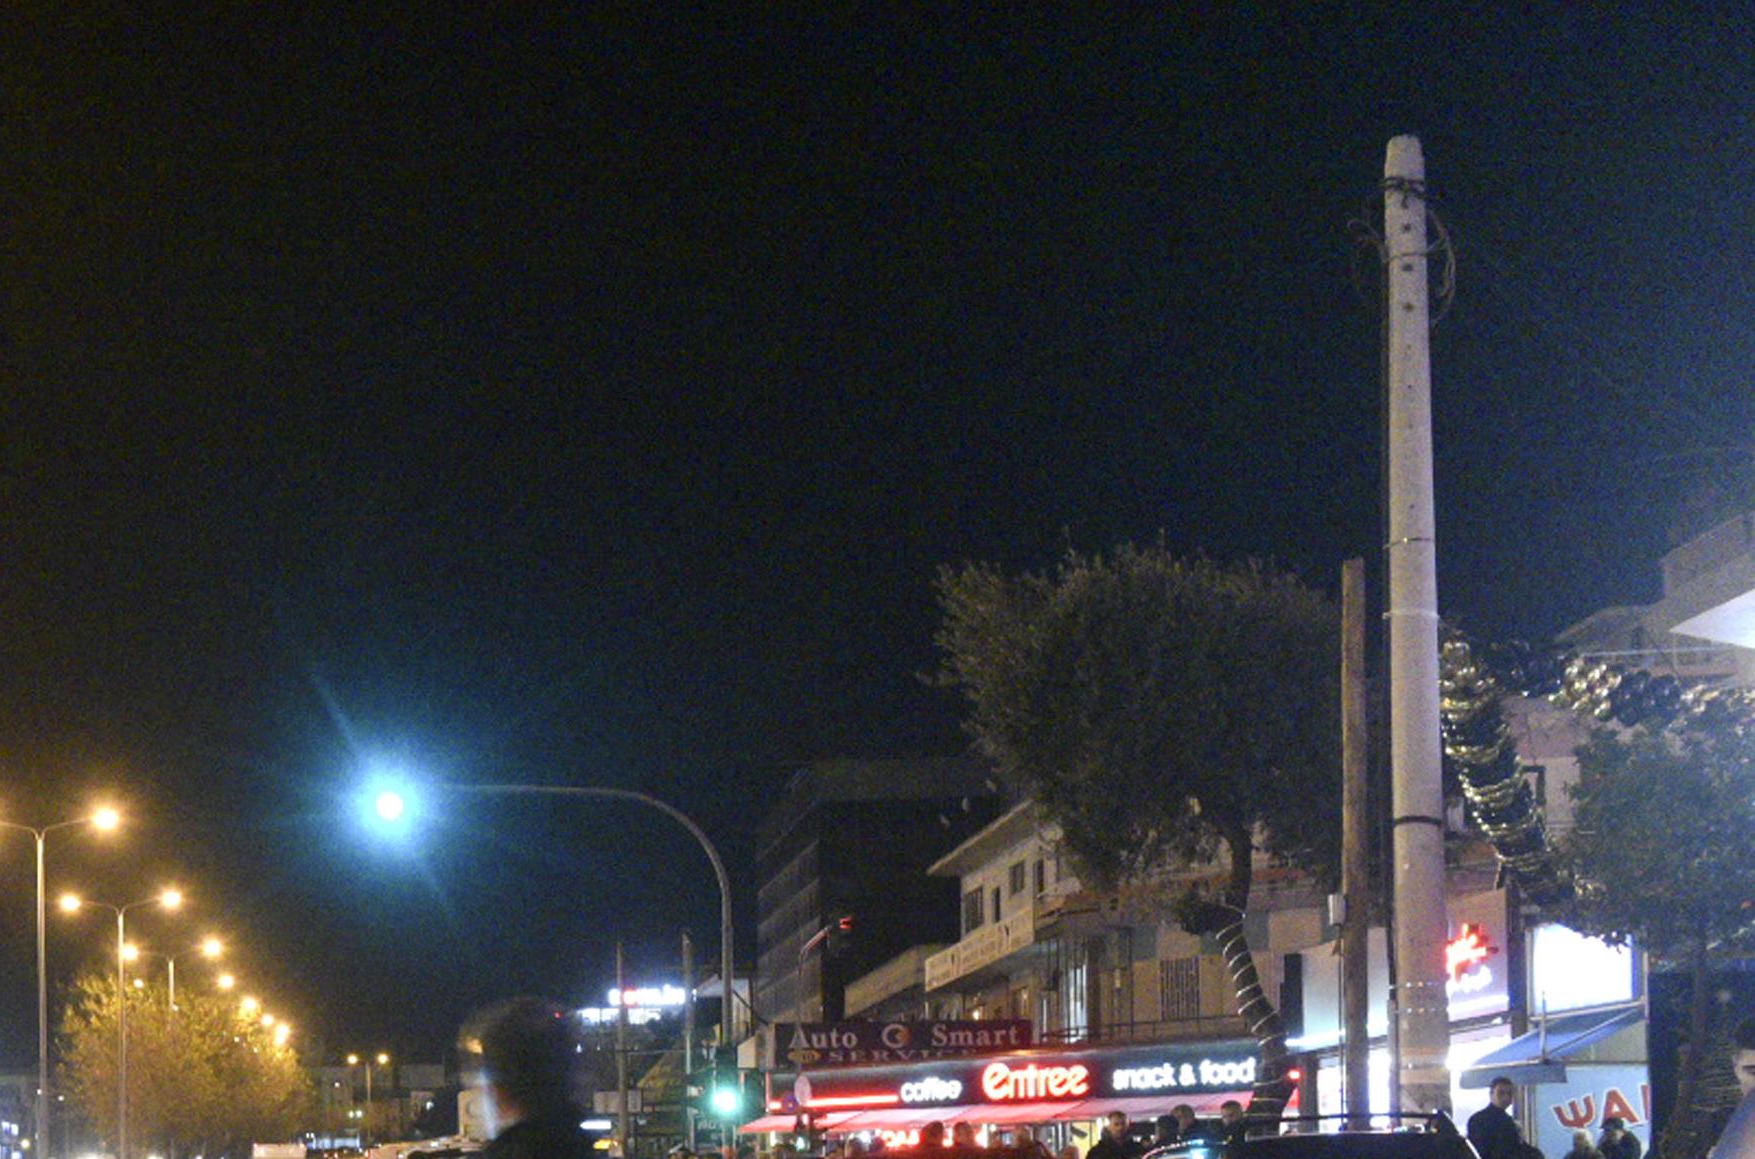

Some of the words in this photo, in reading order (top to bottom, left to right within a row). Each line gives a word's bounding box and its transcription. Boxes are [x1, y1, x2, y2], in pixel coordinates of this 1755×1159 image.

[788, 1026, 858, 1049] Auto
[931, 1024, 1018, 1048] Smart
[900, 1076, 963, 1102] coffee
[1112, 1063, 1177, 1091] snack
[1180, 1064, 1196, 1086] &
[1200, 1057, 1257, 1084] food
[1553, 1084, 1650, 1130] ΨΑ
